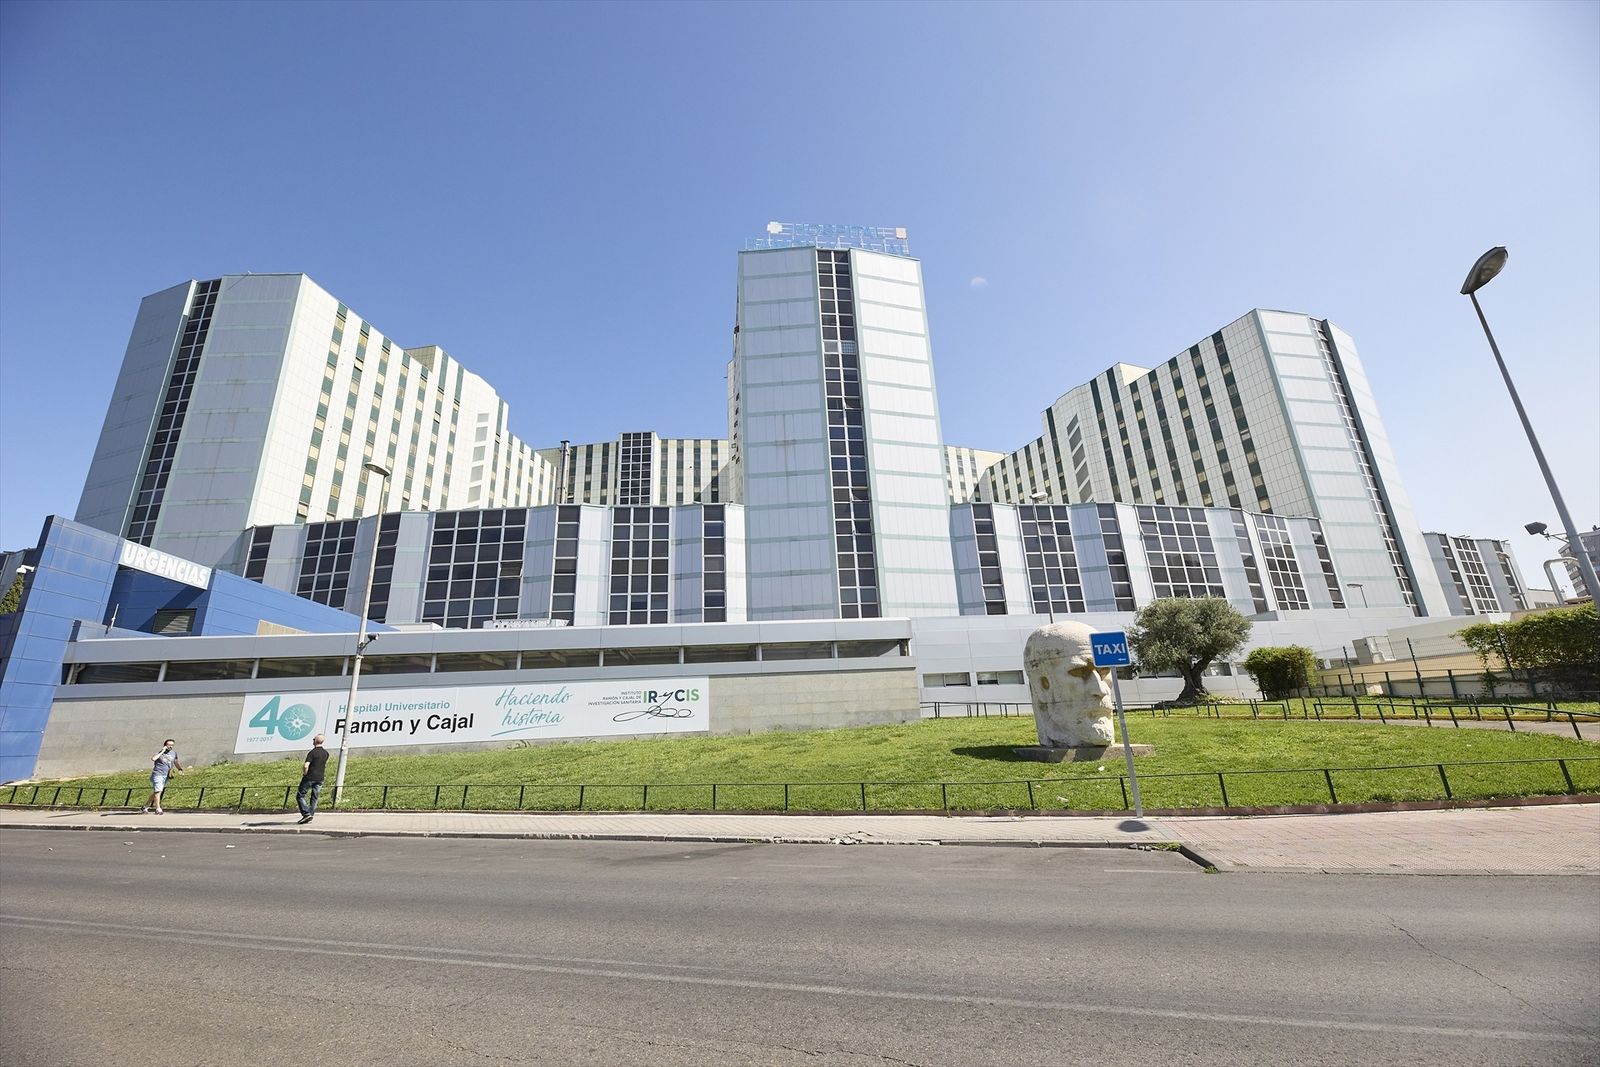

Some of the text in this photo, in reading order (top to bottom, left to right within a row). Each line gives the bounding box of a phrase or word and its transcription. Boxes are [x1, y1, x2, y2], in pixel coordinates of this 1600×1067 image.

[123, 544, 208, 586] URGENCIAS
[1094, 643, 1126, 655] TAXI
[496, 686, 573, 706] Haciendo
[338, 701, 451, 714] Hspital Universitario
[502, 707, 564, 727] historia
[409, 718, 421, 735] y
[426, 713, 474, 733] Cajal
